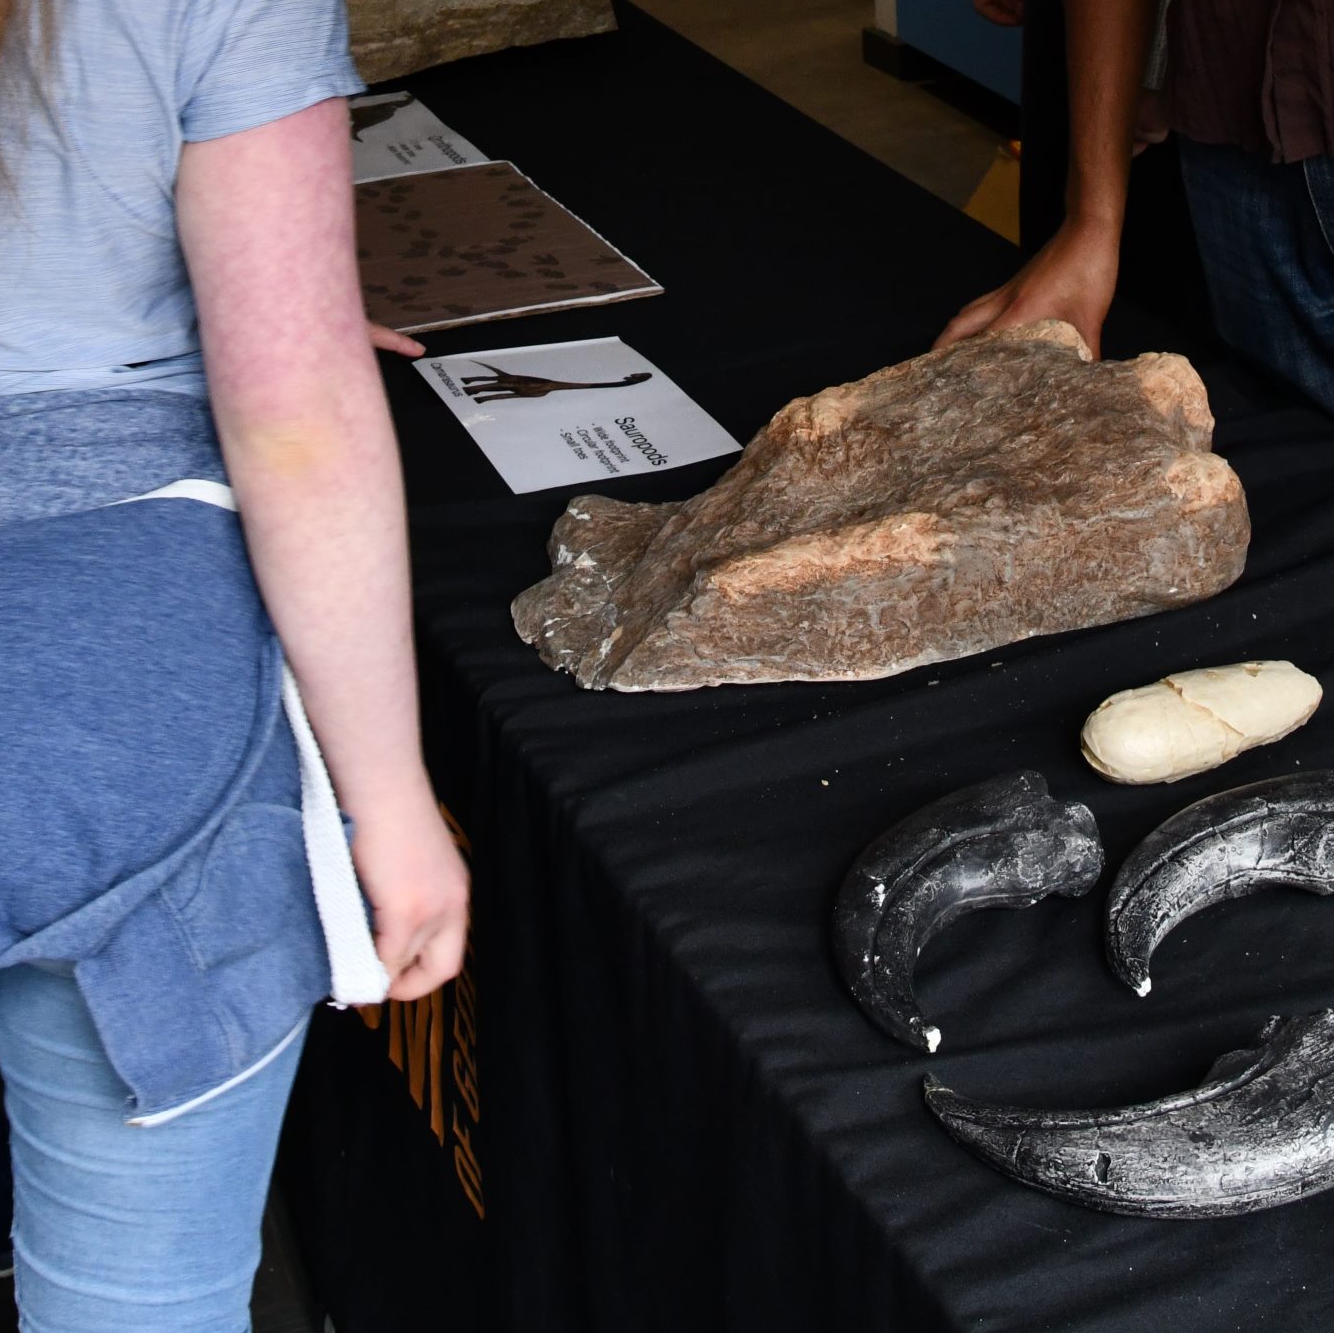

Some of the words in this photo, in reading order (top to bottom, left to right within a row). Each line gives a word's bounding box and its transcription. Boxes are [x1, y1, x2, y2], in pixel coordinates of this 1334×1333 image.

[560, 432, 581, 447] Small
[573, 447, 588, 460] toes
[577, 429, 599, 449] Circular
[594, 449, 620, 474] footprint
[605, 440, 630, 464] footprint
[614, 416, 668, 466] Sauropods
